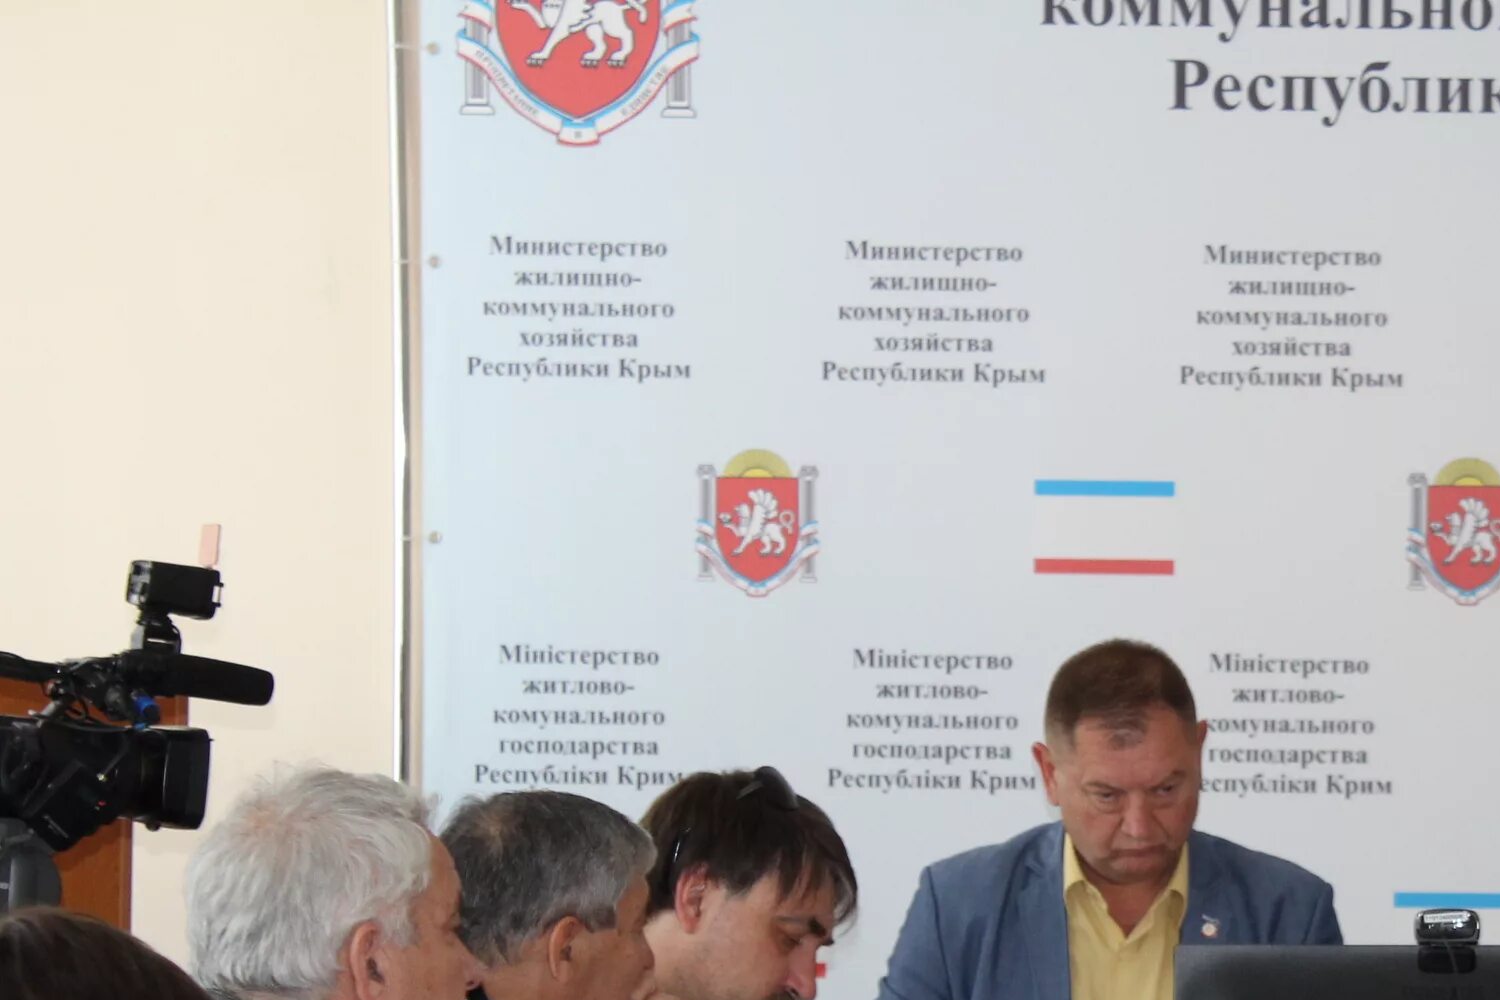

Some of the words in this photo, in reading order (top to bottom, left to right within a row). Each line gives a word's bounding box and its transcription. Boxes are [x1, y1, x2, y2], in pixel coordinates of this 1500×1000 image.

[490, 235, 668, 263] Министерство
[845, 239, 1023, 267] Министерство
[1204, 244, 1382, 272] Министерство
[514, 271, 642, 288] жилищно-
[870, 276, 997, 292] жилищно-
[1228, 280, 1356, 297] жилищно-
[483, 301, 675, 322] коммунального
[838, 306, 1030, 327] коммунального
[1196, 310, 1388, 331] коммунального
[520, 328, 638, 348] хозяйства
[874, 333, 994, 353] хозяйства
[1232, 337, 1352, 357] хозяйства
[467, 356, 609, 382] Республики
[619, 358, 691, 384] Крым
[822, 360, 964, 387] Республики
[973, 362, 1045, 389] Крым
[1180, 365, 1322, 391] Республики
[1331, 367, 1403, 393] Крым
[500, 644, 660, 671] Міністерство
[853, 648, 1014, 675] Міністерство
[1210, 652, 1370, 679] Міністерство
[523, 680, 635, 695] житлово-
[876, 684, 988, 700] житлово-
[1232, 688, 1345, 704] житлово-
[493, 709, 666, 730] комунального
[846, 713, 1019, 734] комунального
[499, 739, 659, 761] господарства
[852, 744, 1012, 765] господарства
[1208, 748, 1368, 769] господарства
[474, 763, 608, 789] Республіки
[828, 768, 961, 794] Республіки
[970, 769, 1036, 796] Крим
[1200, 773, 1317, 798] еспубліки
[1326, 774, 1393, 800] Крим
